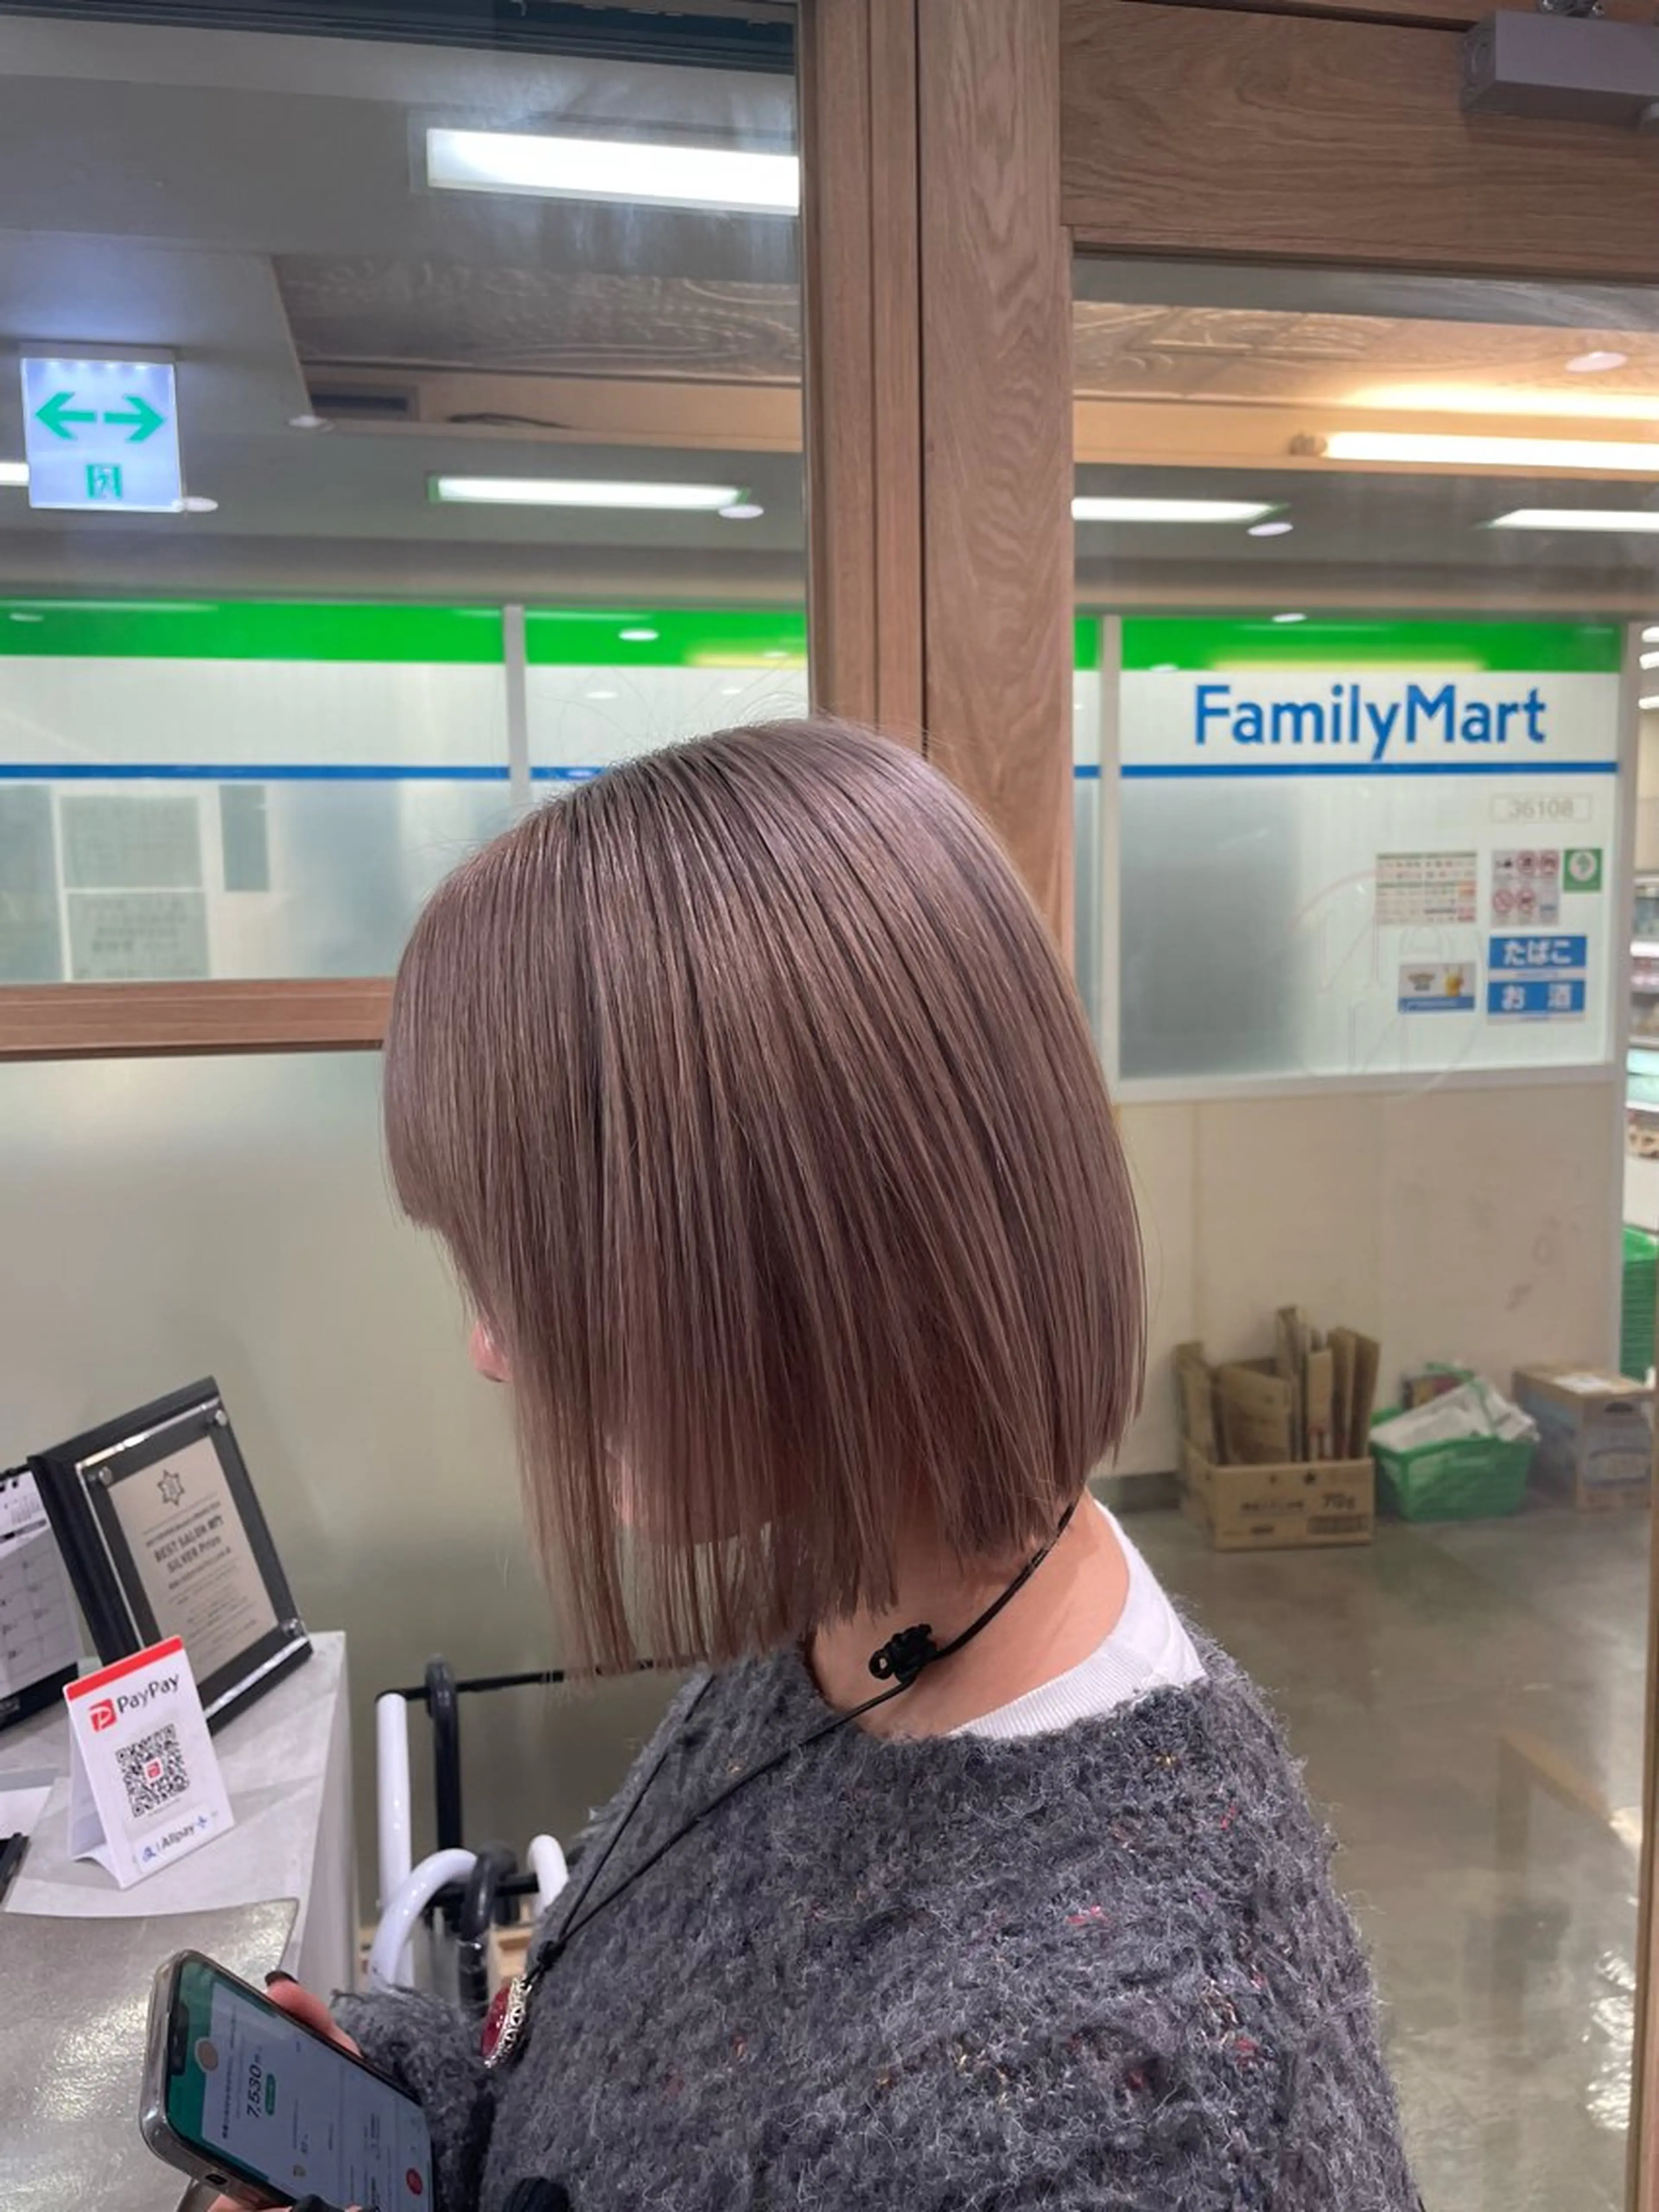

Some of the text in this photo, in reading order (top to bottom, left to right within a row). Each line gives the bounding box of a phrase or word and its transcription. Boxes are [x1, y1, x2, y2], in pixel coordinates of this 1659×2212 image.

[1195, 684, 1547, 761] FamilyMart
[1504, 939, 1572, 966] たばこ
[117, 1673, 179, 1714] PayPay
